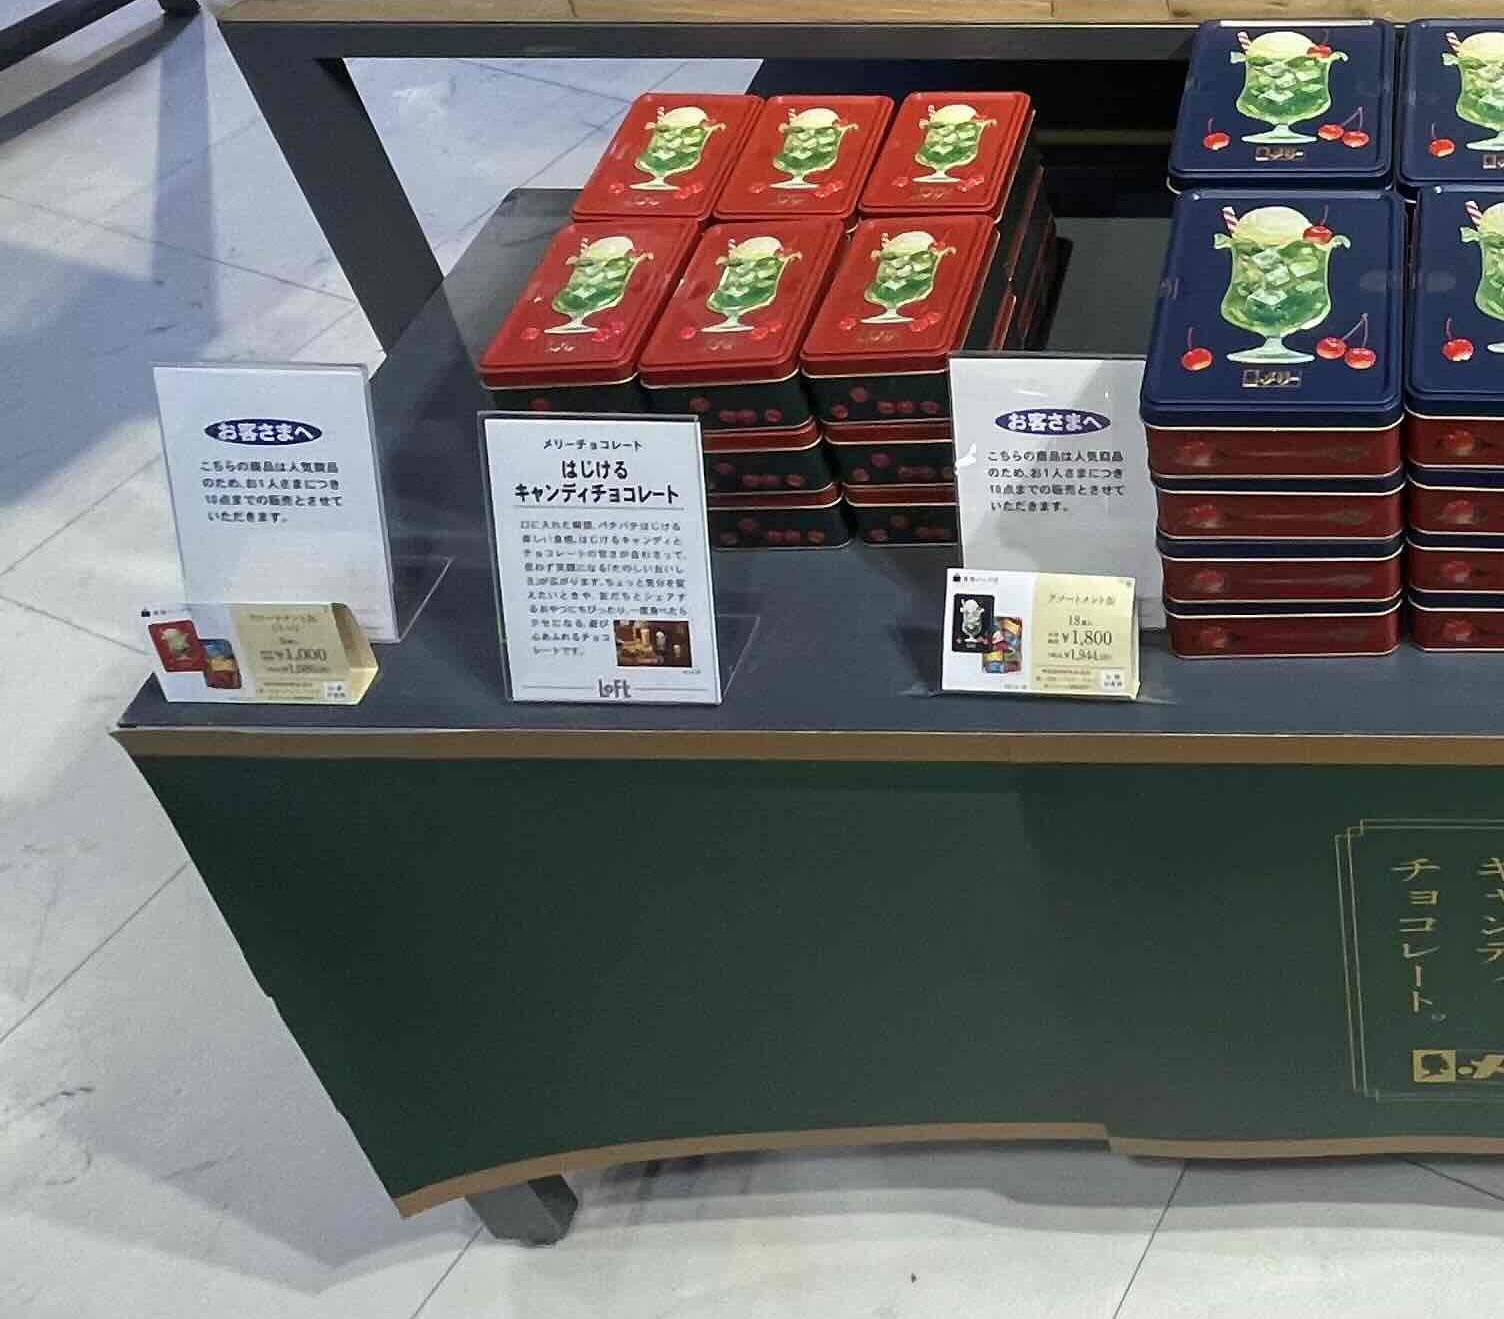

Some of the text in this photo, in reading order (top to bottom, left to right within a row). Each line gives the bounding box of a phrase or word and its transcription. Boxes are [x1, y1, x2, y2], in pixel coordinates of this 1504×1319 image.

[1008, 412, 1103, 431] お客さまへ
[217, 422, 315, 443] お客さまへ
[543, 439, 643, 452] メリーチョコレート
[562, 459, 629, 480] はじける
[514, 483, 680, 504] キャンディチョコレート
[1062, 630, 1113, 647] ¥1,800
